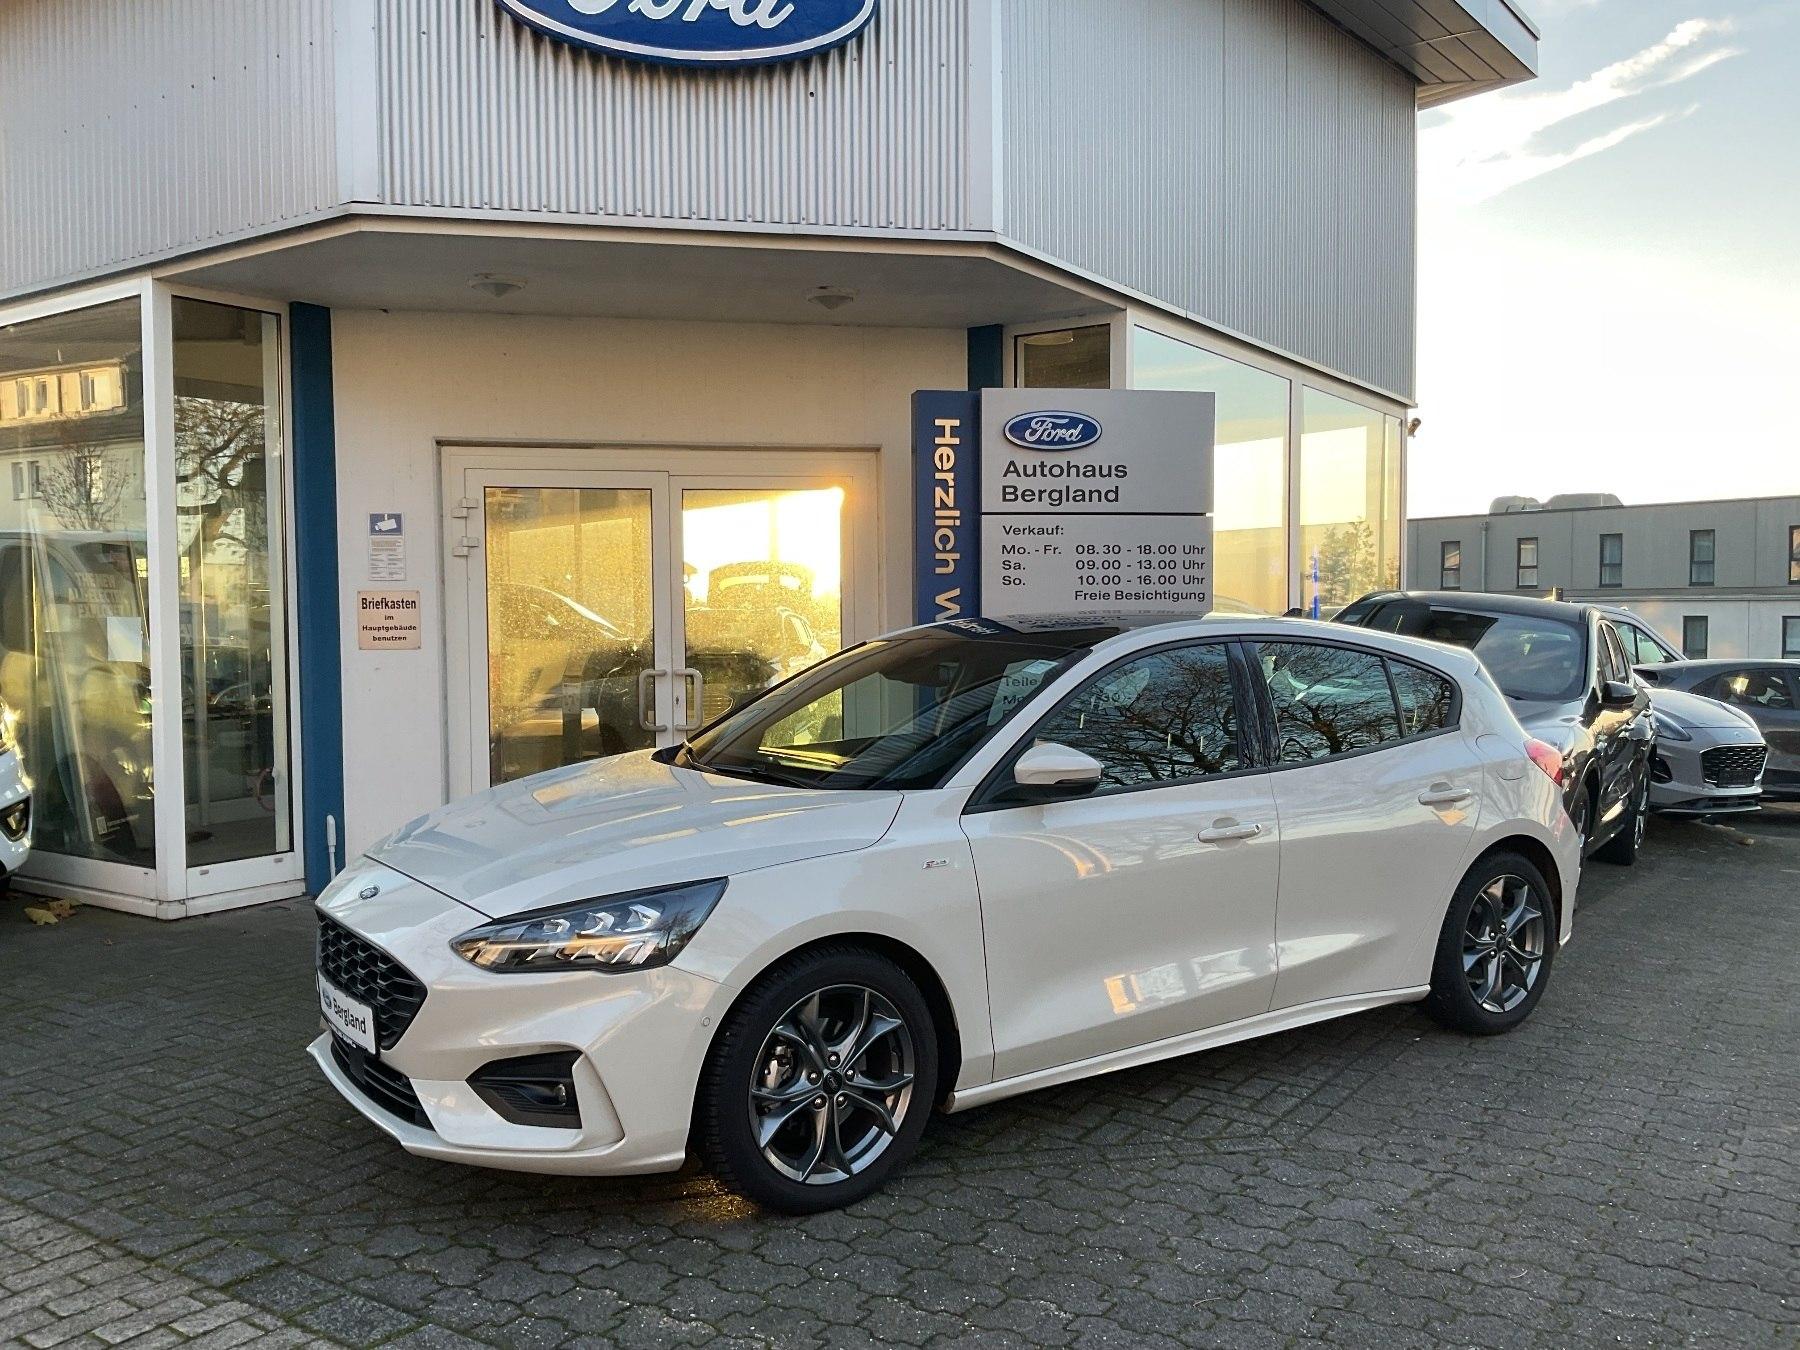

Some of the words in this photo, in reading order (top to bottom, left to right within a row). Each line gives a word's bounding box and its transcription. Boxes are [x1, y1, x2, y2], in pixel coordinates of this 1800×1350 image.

[1024, 416, 1084, 442] Ford
[1002, 460, 1128, 479] Autohaus
[934, 418, 961, 574] Herzlich
[1001, 485, 1119, 507] Bergland
[1002, 525, 1064, 536] Verkauf:
[1001, 544, 1031, 555] Mo.
[1043, 544, 1062, 555] Fr.
[1075, 544, 1121, 555] 08.30
[1137, 544, 1177, 555] 18.00
[1183, 544, 1205, 555] Uhr
[1002, 560, 1026, 570] Sa.
[1075, 560, 1121, 570] 09.00
[1137, 560, 1177, 570] 13.00
[1183, 560, 1205, 570] Uhr
[1002, 575, 1026, 586] So.
[1078, 575, 1121, 586] 10.00
[1137, 575, 1177, 586] 16.00
[1183, 575, 1205, 586] Uhr
[1074, 590, 1111, 600] Freie
[1114, 590, 1205, 602] Besichtigung
[361, 597, 417, 610] Briefkasten
[362, 624, 417, 633] Hauptgebäude
[333, 997, 367, 1035] Bergland
